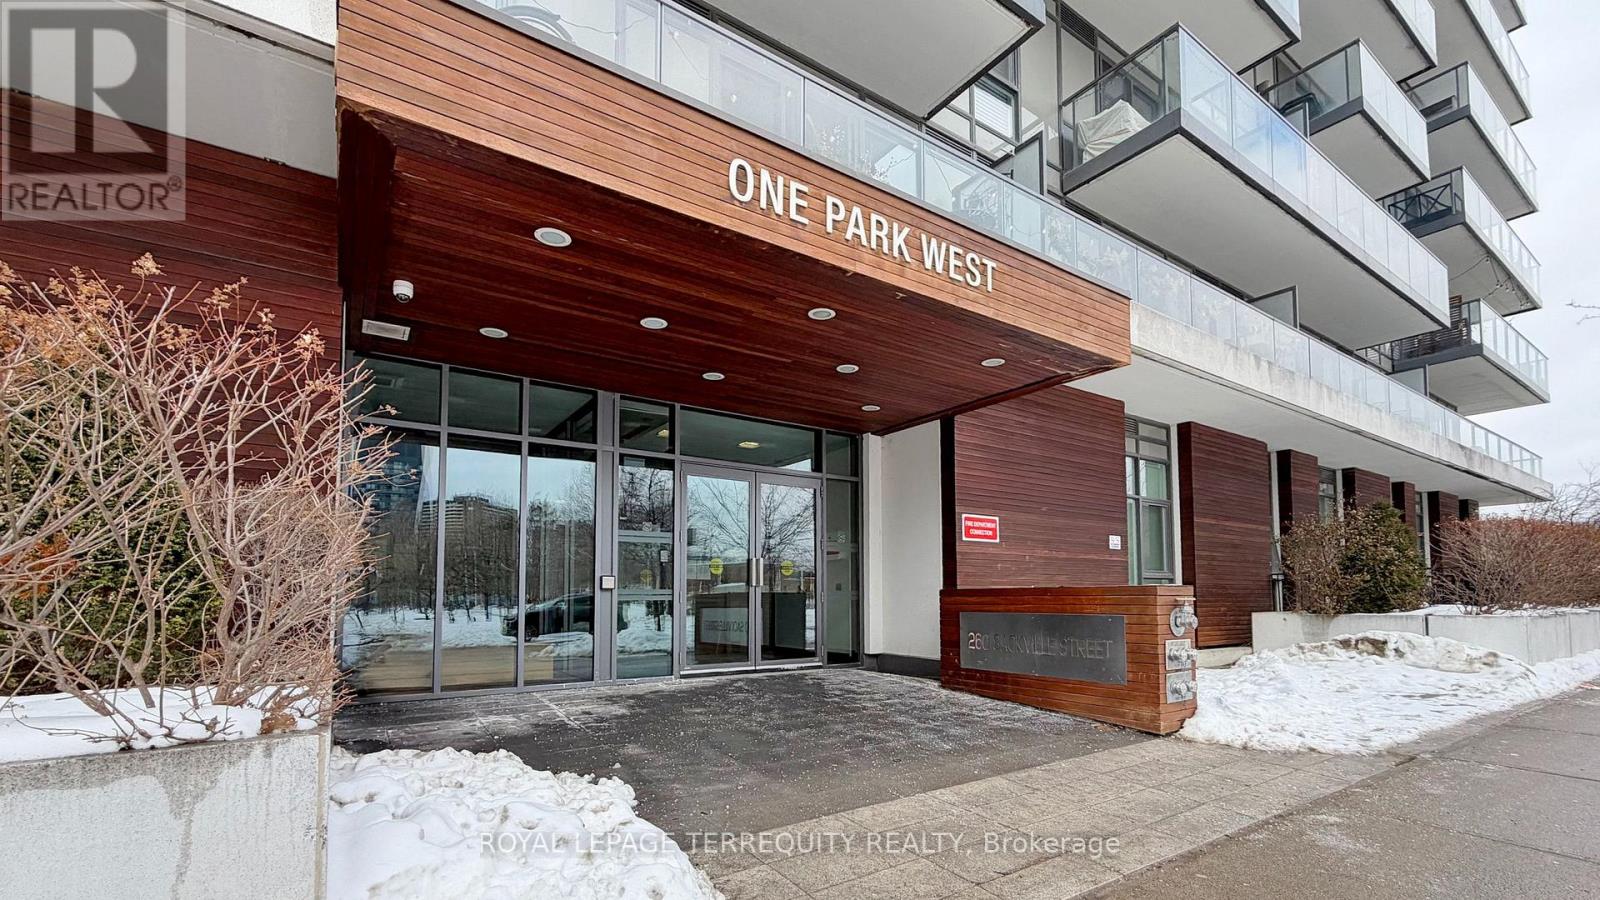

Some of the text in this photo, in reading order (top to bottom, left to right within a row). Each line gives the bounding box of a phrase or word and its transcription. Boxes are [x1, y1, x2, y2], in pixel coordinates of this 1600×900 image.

[728, 157, 997, 293] ONE PARK WEST
[1058, 637, 1114, 659] STREET
